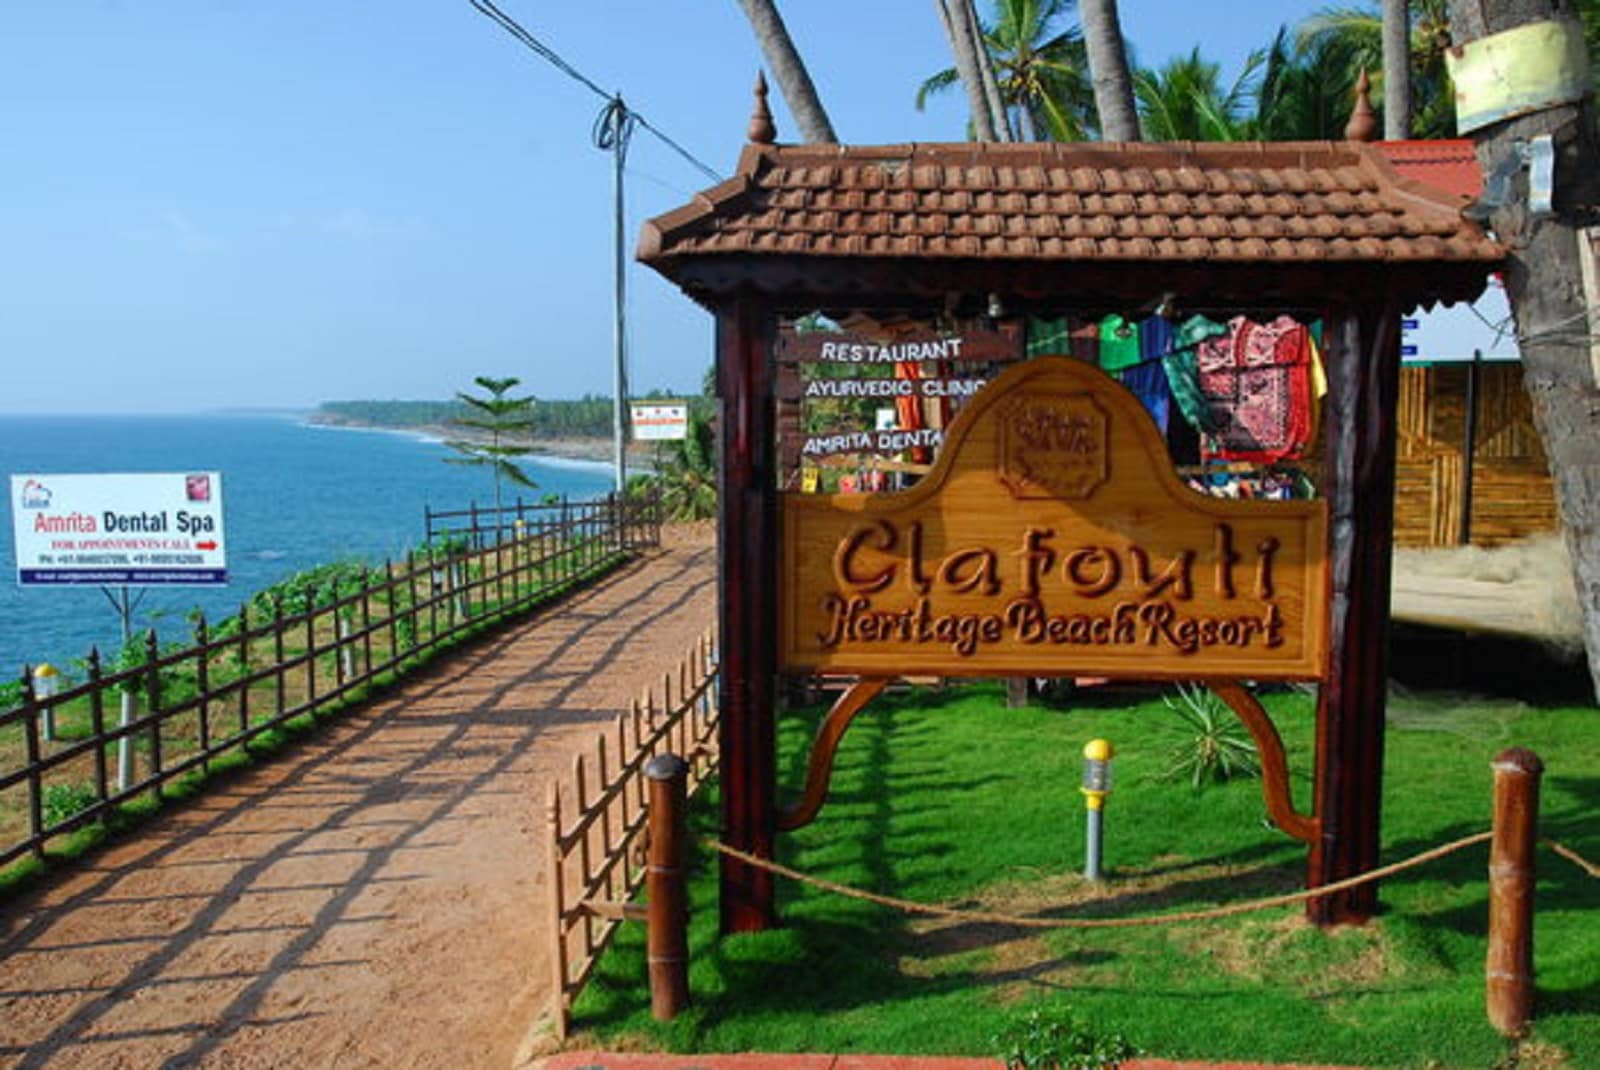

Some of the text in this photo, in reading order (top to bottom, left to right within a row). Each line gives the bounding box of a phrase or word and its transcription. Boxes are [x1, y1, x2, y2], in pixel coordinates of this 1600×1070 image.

[821, 339, 962, 362] RESTAURANT
[805, 380, 912, 396] AYURVEDIC
[803, 433, 872, 454] AMRITA
[34, 511, 214, 536] Amrita Dental Spa
[834, 518, 1279, 600] Clafouti
[817, 592, 1285, 656] Heritage Beach Resort
